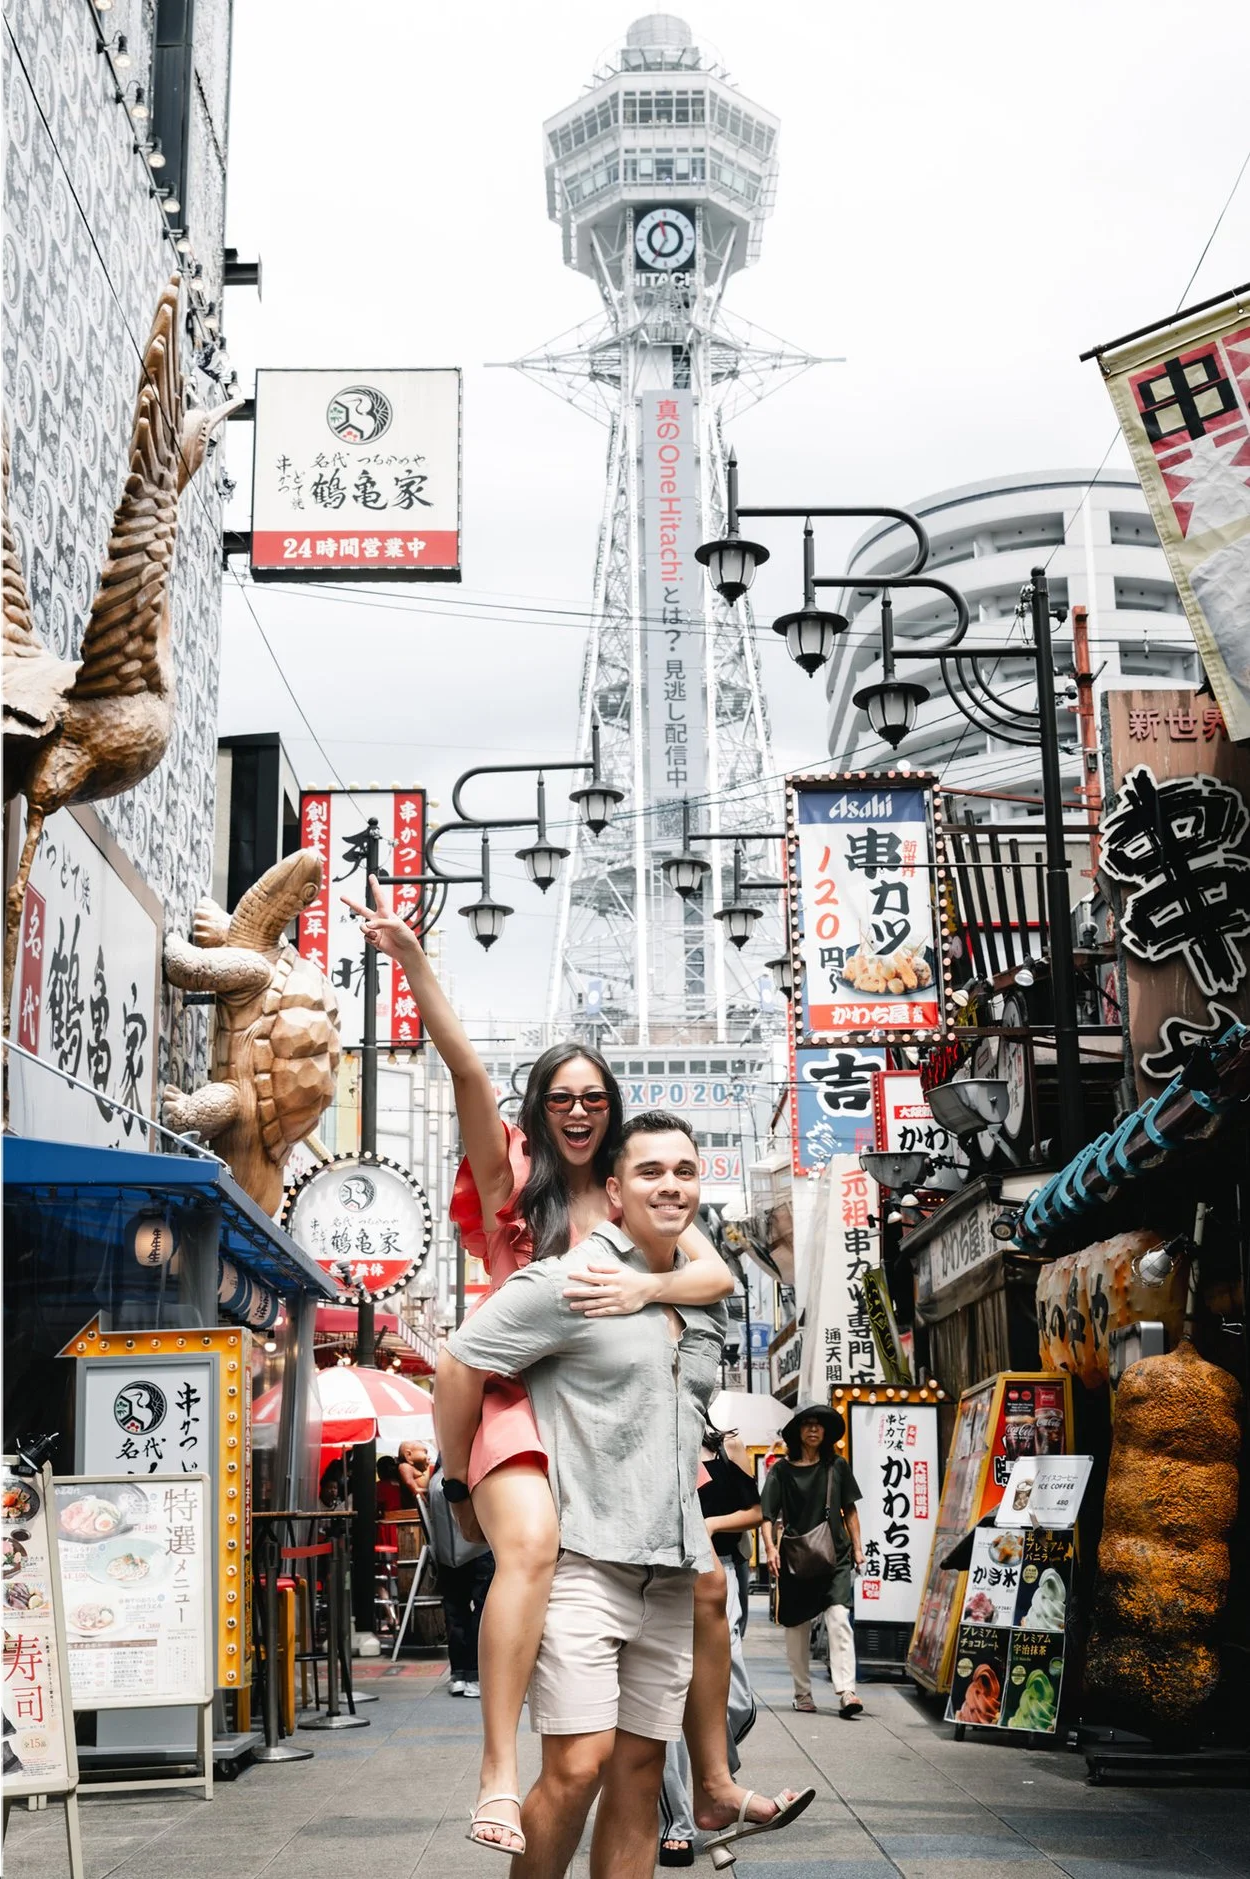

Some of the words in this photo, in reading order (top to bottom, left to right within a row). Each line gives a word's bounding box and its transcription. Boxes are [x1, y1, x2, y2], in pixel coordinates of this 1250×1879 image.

[283, 537, 427, 559] 24時間営業中
[828, 794, 893, 819] Asahi
[844, 827, 911, 956] 串カツ
[831, 1004, 910, 1025] かわち屋
[825, 1327, 843, 1382] 通天閣
[116, 1437, 166, 1460] 名代
[880, 1455, 913, 1584] かわち屋
[163, 1488, 198, 1623] 特選メニュー
[972, 1565, 1018, 1587] かき氷
[962, 1627, 998, 1639] プレミアム
[1014, 1632, 1051, 1644] プレミアム
[960, 1639, 999, 1651] チョコレート
[4, 1634, 44, 1723] 寿司
